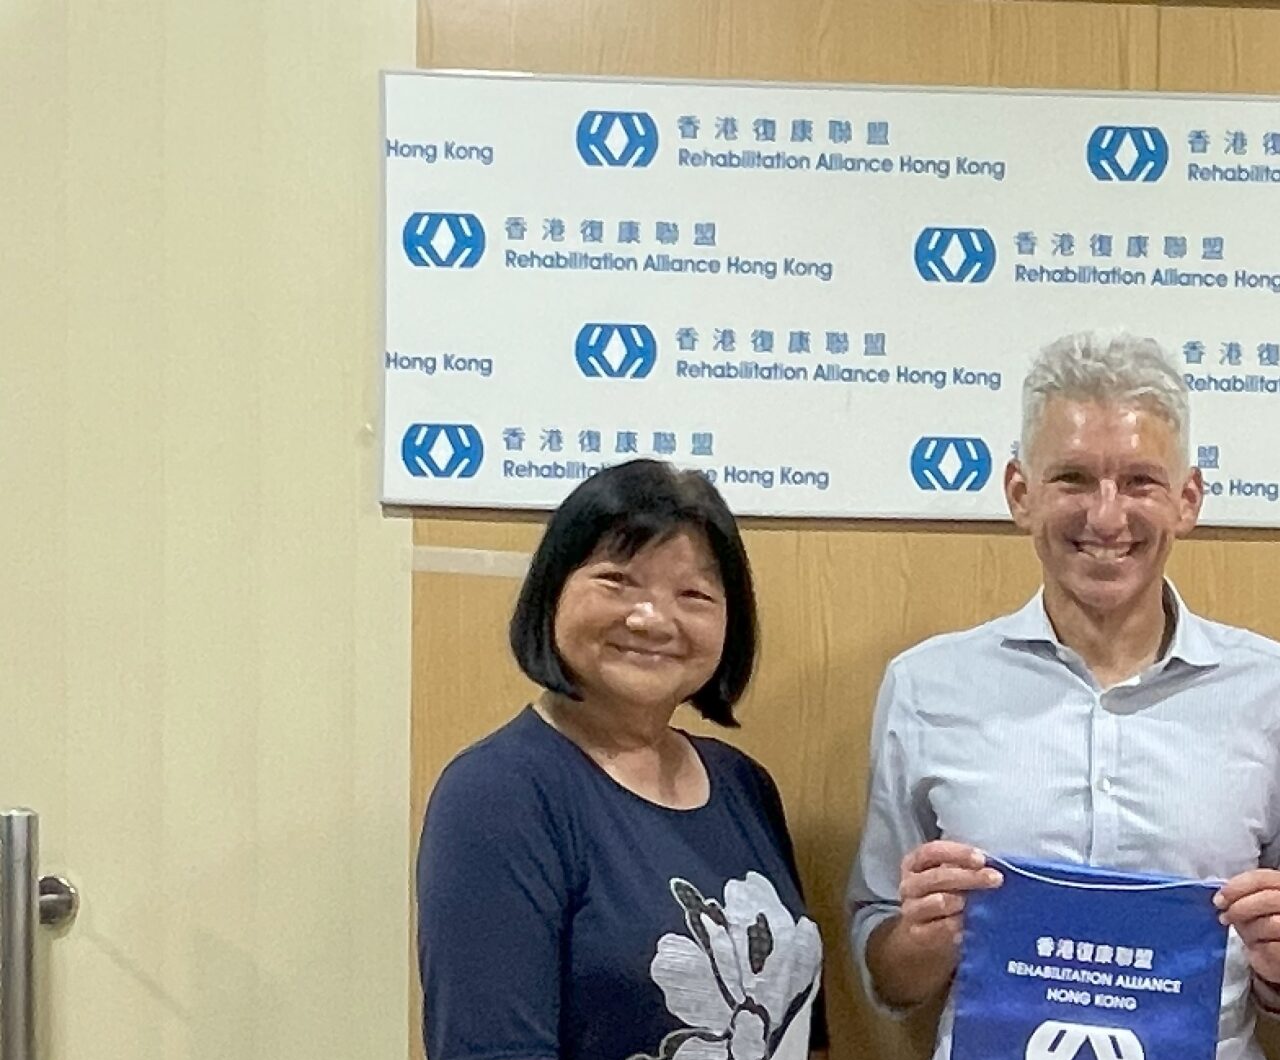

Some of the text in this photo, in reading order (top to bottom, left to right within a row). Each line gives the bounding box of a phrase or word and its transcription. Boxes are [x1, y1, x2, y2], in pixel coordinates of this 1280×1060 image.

[677, 116, 889, 145] 香港復康聯盟
[386, 139, 493, 165] Hong Kong
[679, 148, 1005, 181] Rehabilitation Alliance Hong Kong
[505, 217, 716, 246] 香港復康聯盟
[1014, 231, 1224, 260] 香港復康聯盟
[505, 250, 833, 281] Rehabilitation Alliance Hong Kong
[1015, 264, 1146, 285] Rehabilitation
[1151, 268, 1228, 287] Alliance
[676, 327, 886, 356] 香港復康聯盟
[386, 352, 493, 377] Hong Kong
[676, 360, 1001, 390] Rehabilitation Alliance Hong Kong
[502, 428, 713, 456] 香港復康聯盟
[503, 459, 604, 479] Rehabilita
[724, 466, 774, 488] Hong
[780, 467, 829, 490] Kong
[1229, 479, 1278, 501] Hong
[1008, 959, 1182, 993] REHABILITATION ALLIANCE
[1047, 988, 1136, 1010] HONG KONG
